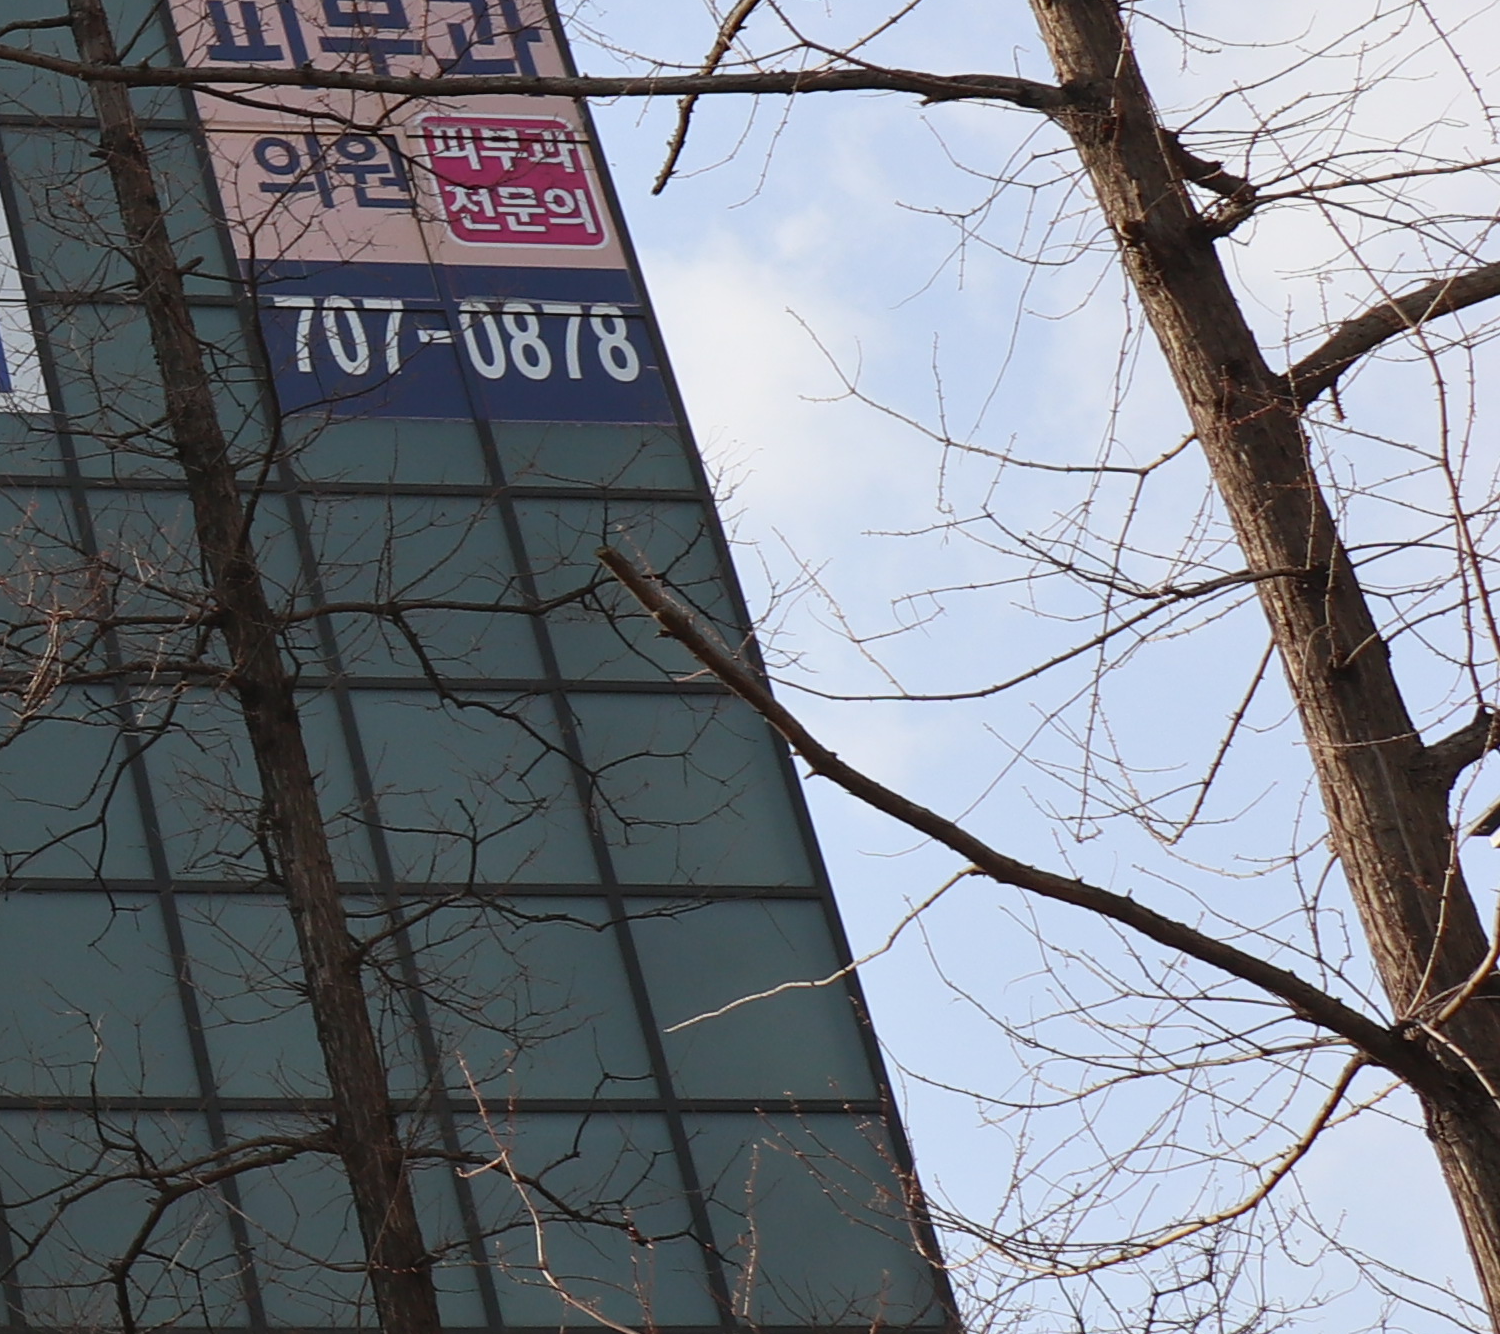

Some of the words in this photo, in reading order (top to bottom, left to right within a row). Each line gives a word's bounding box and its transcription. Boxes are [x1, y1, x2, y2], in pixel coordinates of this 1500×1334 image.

[253, 133, 415, 209] 의원
[425, 124, 577, 174] 피부과
[444, 185, 598, 234] 전문의
[273, 294, 640, 383] 707-0878
